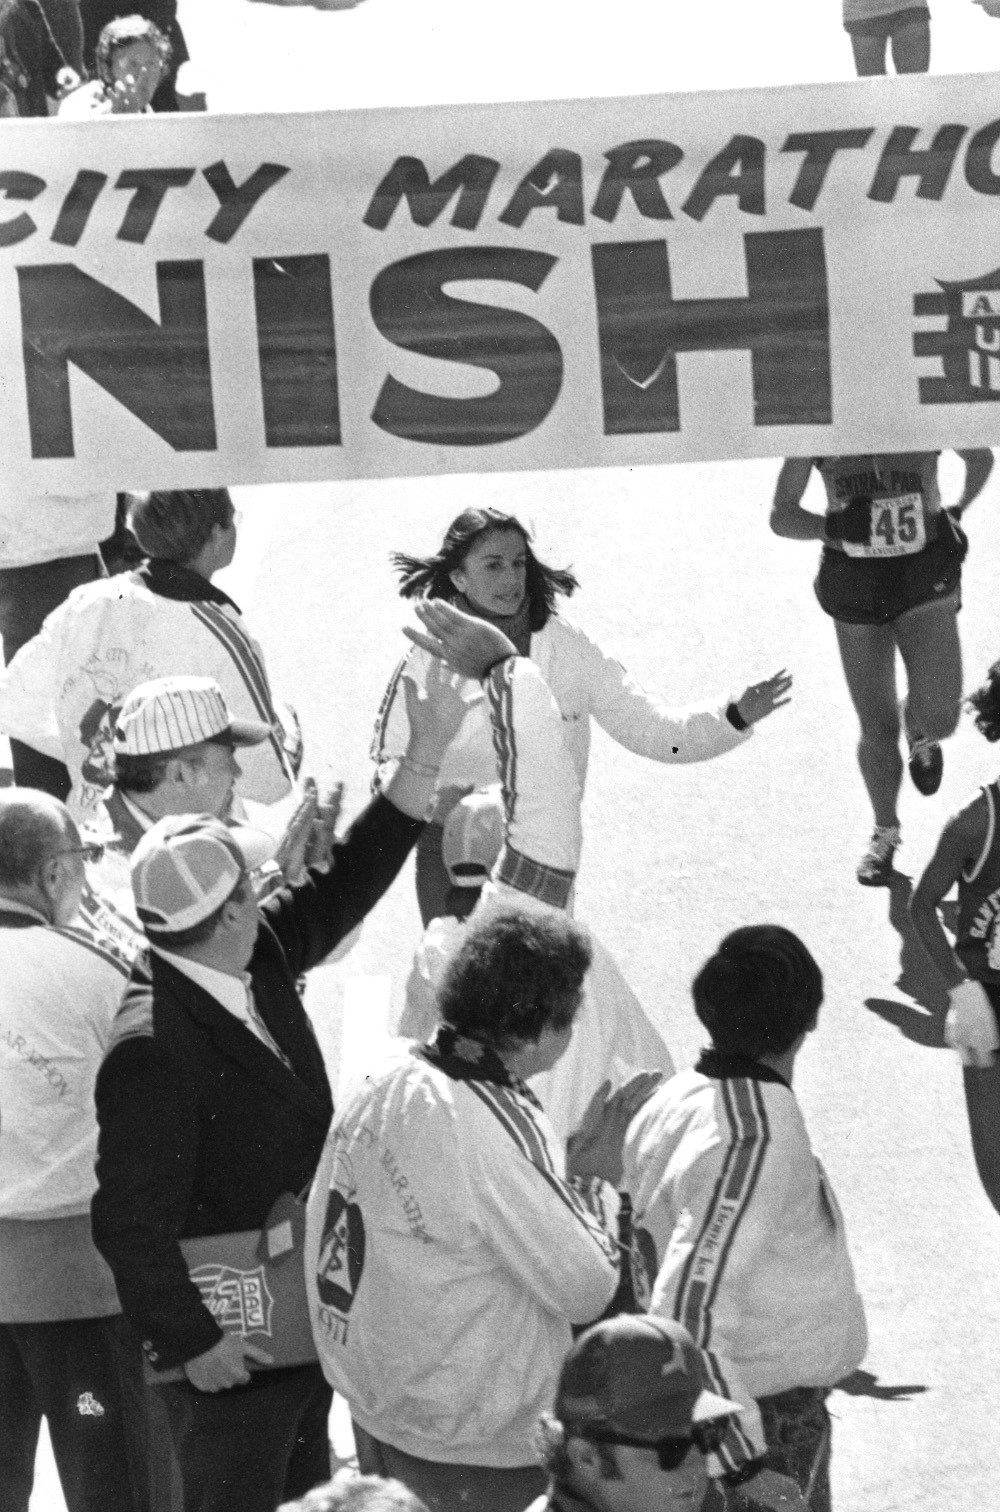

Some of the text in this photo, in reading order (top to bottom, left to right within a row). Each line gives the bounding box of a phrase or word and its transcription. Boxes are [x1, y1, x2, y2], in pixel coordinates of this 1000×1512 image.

[0, 160, 291, 248] CITY
[16, 227, 833, 459] NISH
[244, 1282, 261, 1322] AAU
